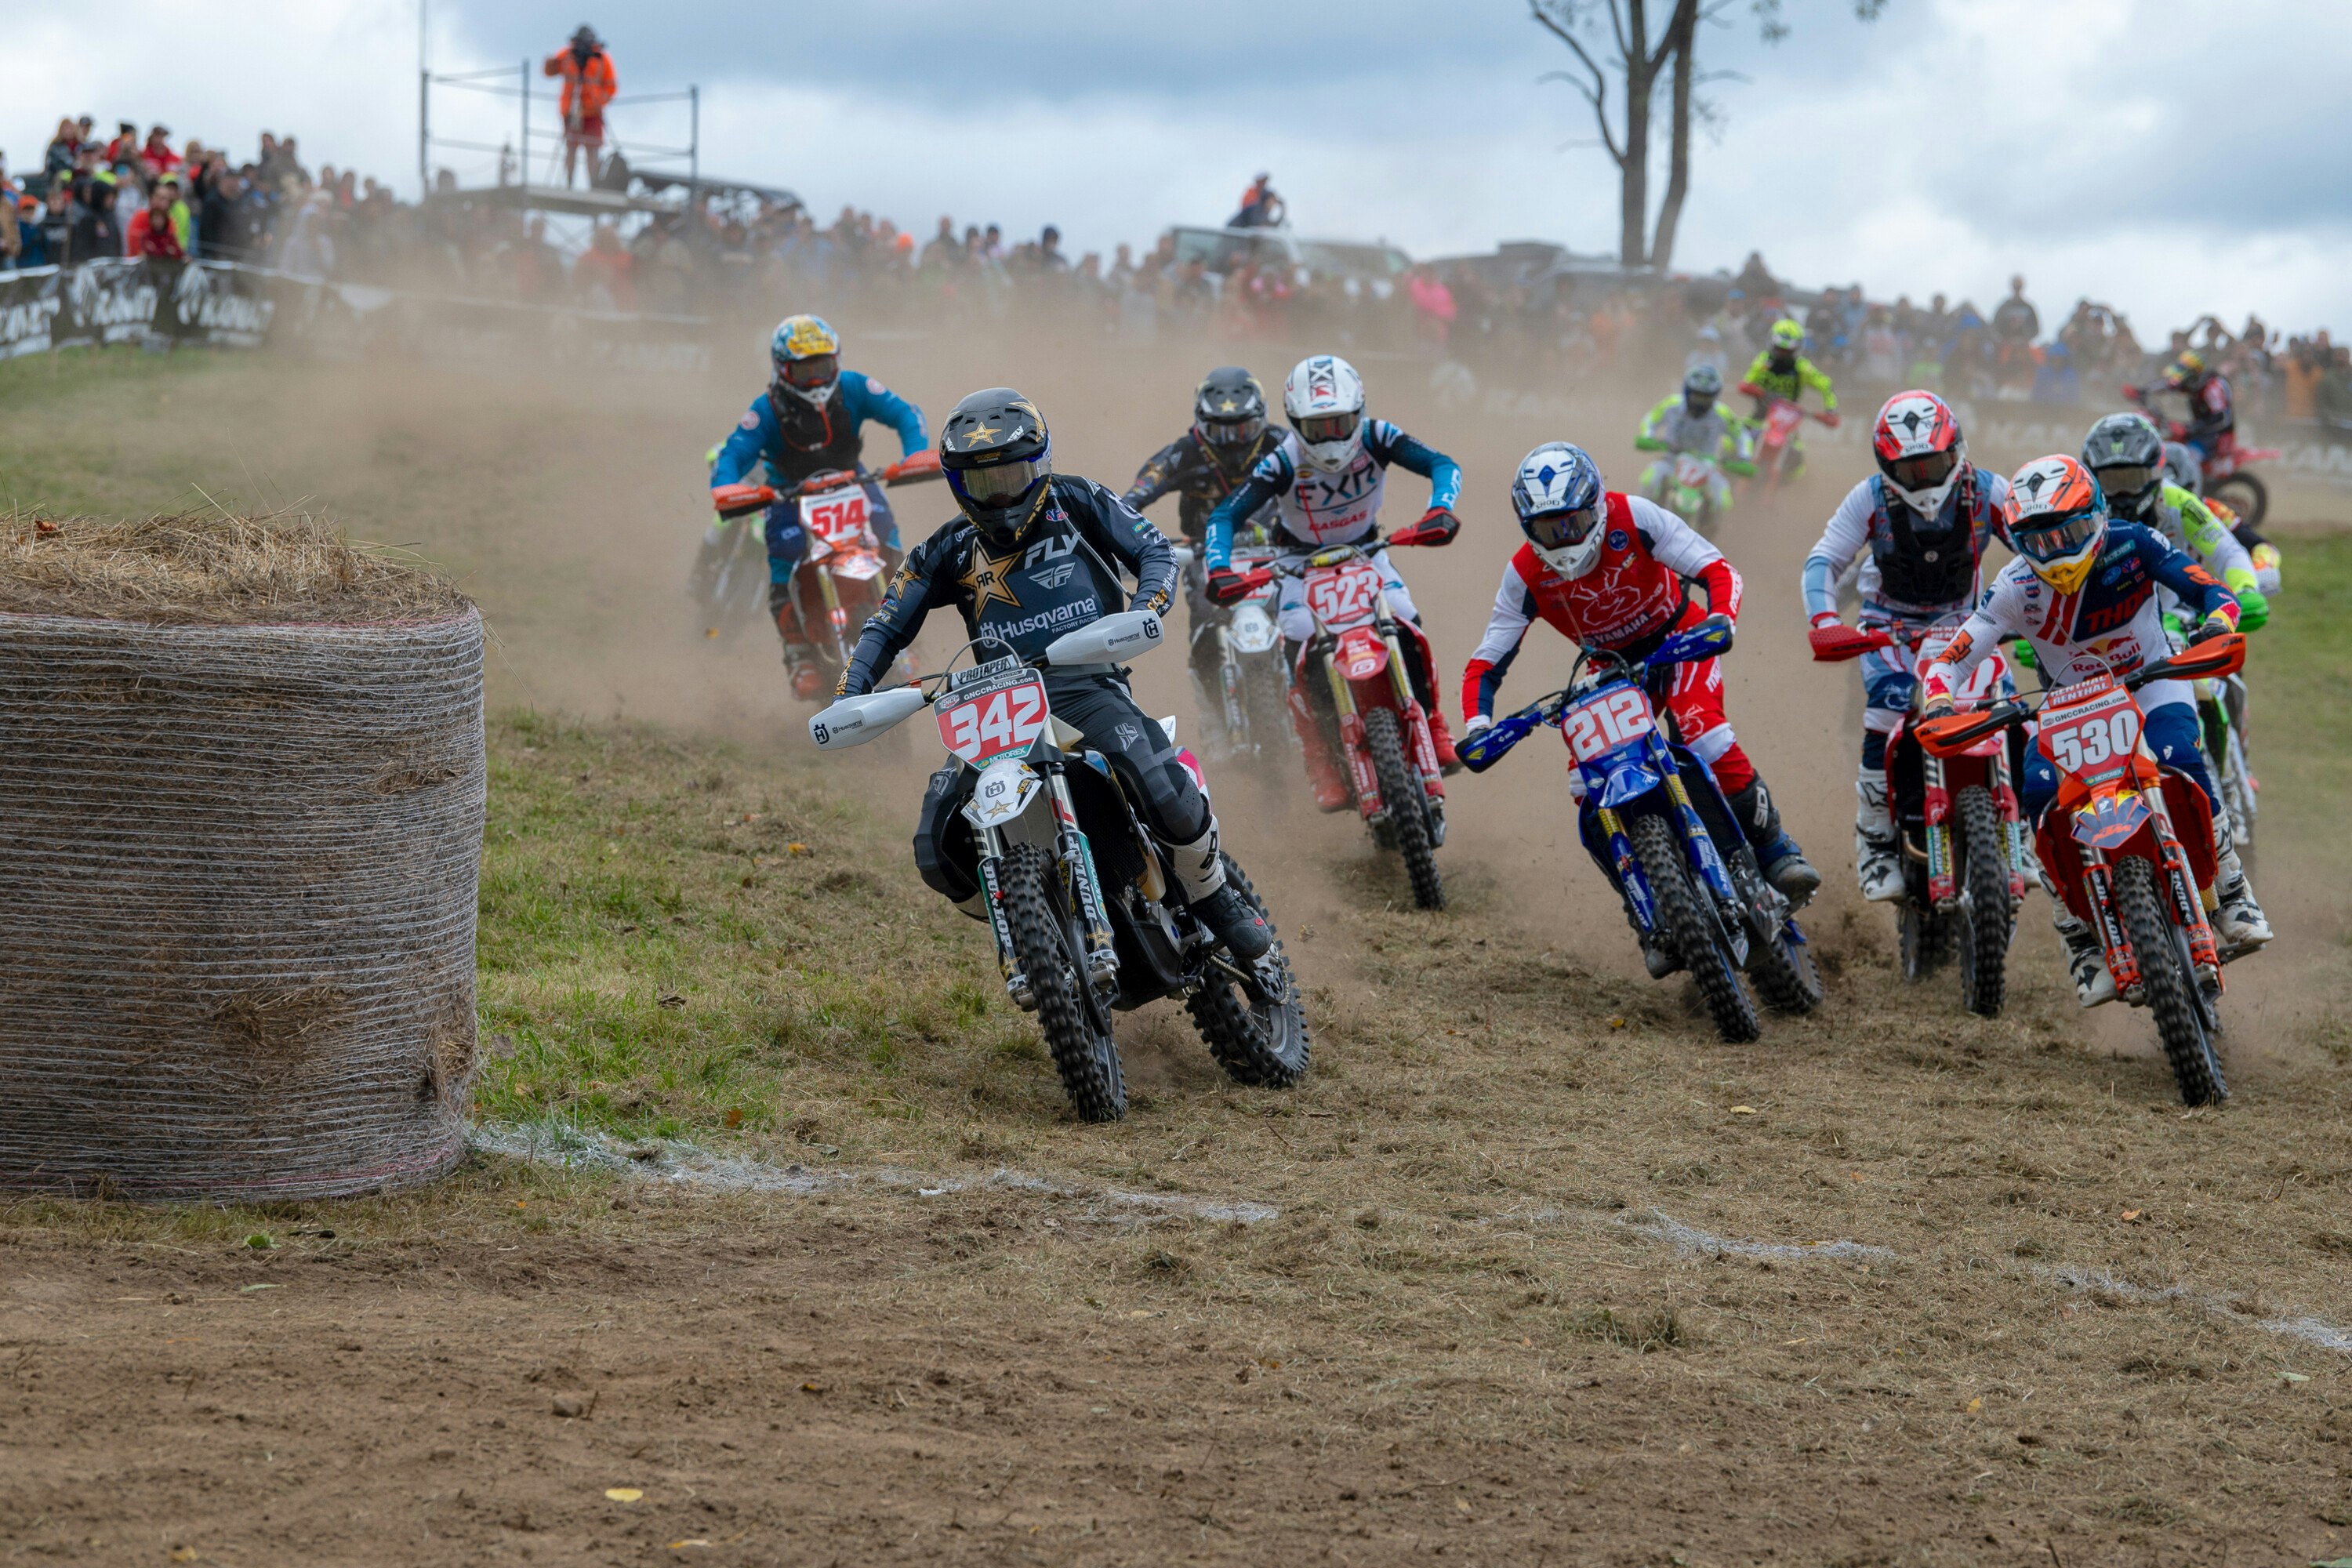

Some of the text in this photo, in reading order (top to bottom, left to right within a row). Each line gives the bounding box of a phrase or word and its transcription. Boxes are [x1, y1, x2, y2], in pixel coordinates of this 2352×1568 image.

[1905, 444, 1929, 452] SHOEI
[1535, 499, 1560, 510] SHOEI
[2022, 504, 2048, 514] SHOEI
[812, 499, 866, 537] 514
[1308, 510, 1367, 532] GASGAS
[1024, 532, 1081, 570] FLY
[1315, 570, 1379, 621] 523
[2085, 579, 2154, 633] THOR
[997, 597, 1097, 641] Husqvarna
[1051, 615, 1099, 633] FACTORY RACING
[1595, 612, 1650, 643] YAMAHA
[1114, 632, 1140, 644] Husqvarna
[2109, 642, 2141, 662] Bull
[960, 659, 1008, 683] PROTAPER
[964, 677, 1034, 701] GNCCRACING.COM
[2049, 676, 2107, 697] RENTHAL
[2053, 682, 2109, 706] RENTHAL
[2055, 696, 2126, 722] GNCCRACING.COM
[838, 720, 862, 731] Husqvarna
[949, 685, 1041, 760] 342
[1565, 690, 1650, 762] 212
[2052, 710, 2139, 774] 530
[989, 747, 1025, 764] MOTOREX
[2094, 770, 2122, 781] MOTOREX
[2091, 823, 2132, 844] KTM
